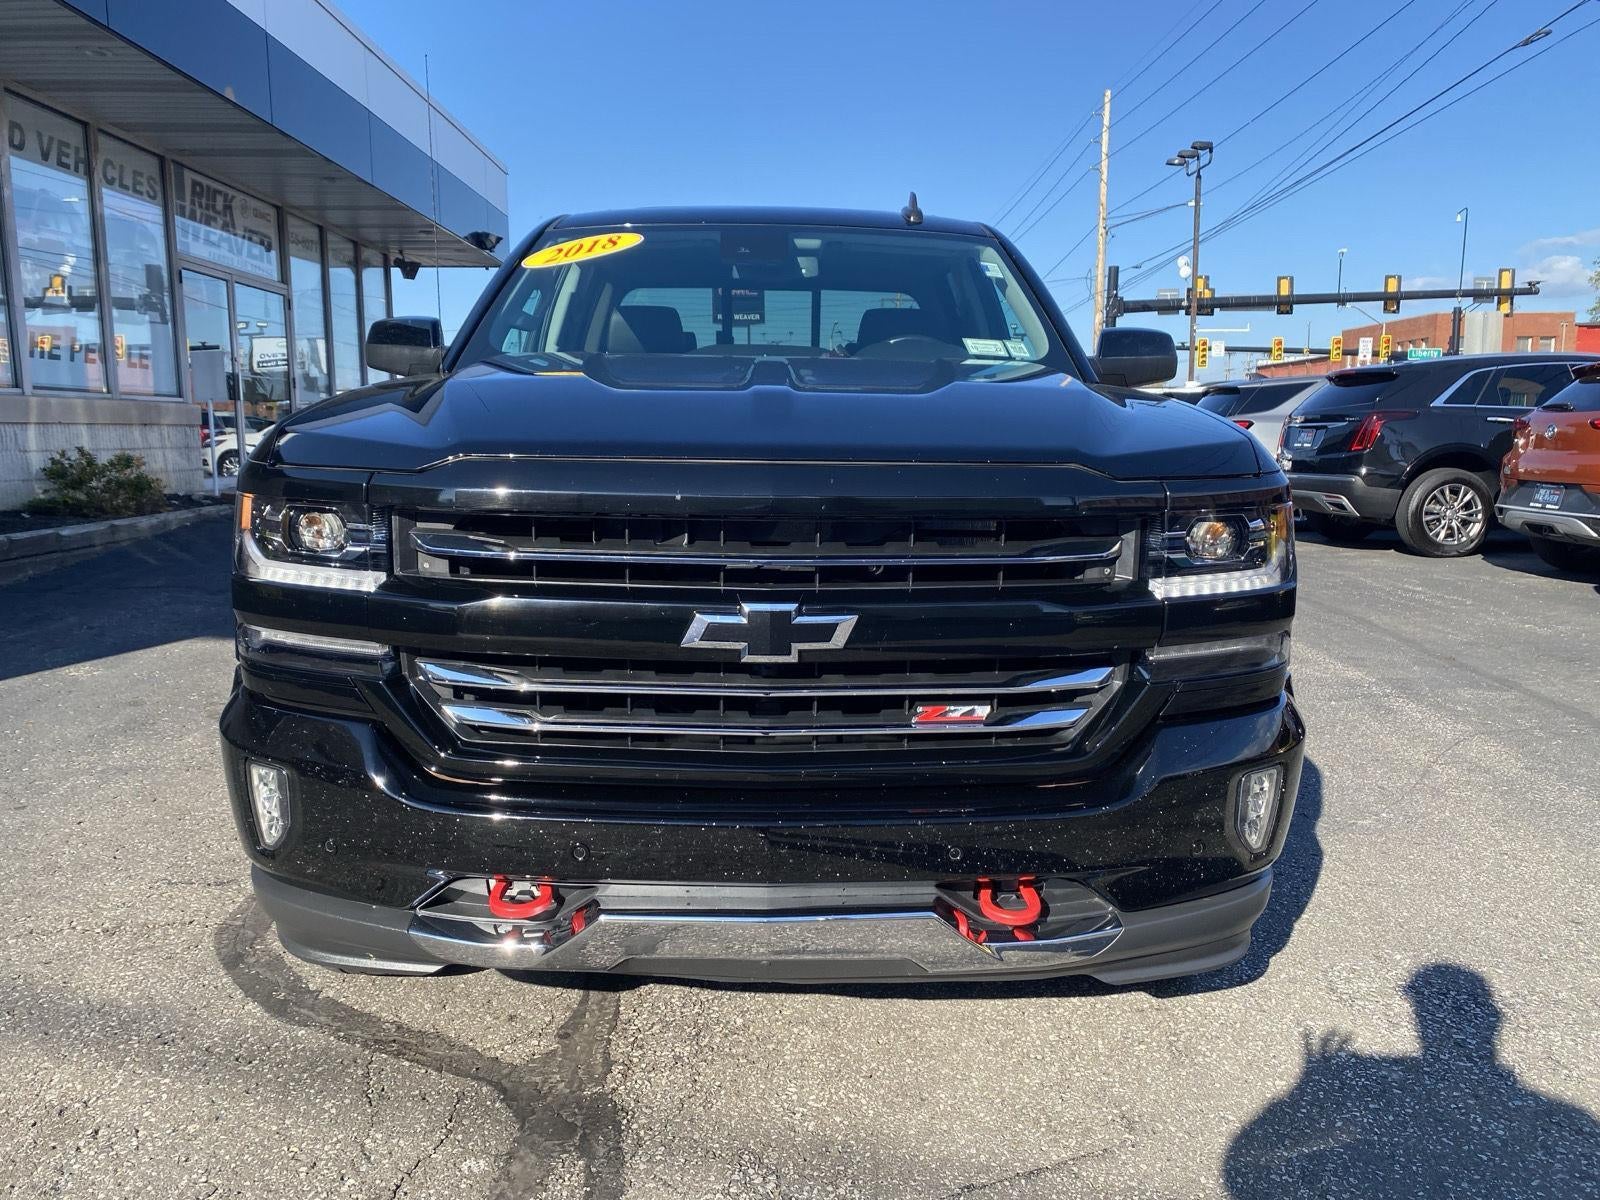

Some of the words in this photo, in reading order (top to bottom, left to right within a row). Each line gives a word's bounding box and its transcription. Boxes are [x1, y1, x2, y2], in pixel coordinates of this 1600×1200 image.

[36, 130, 158, 201] VEHCLES
[190, 178, 237, 219] RICK
[544, 235, 622, 264] 2018
[1412, 349, 1438, 358] Liberty
[912, 704, 991, 724] Z71
